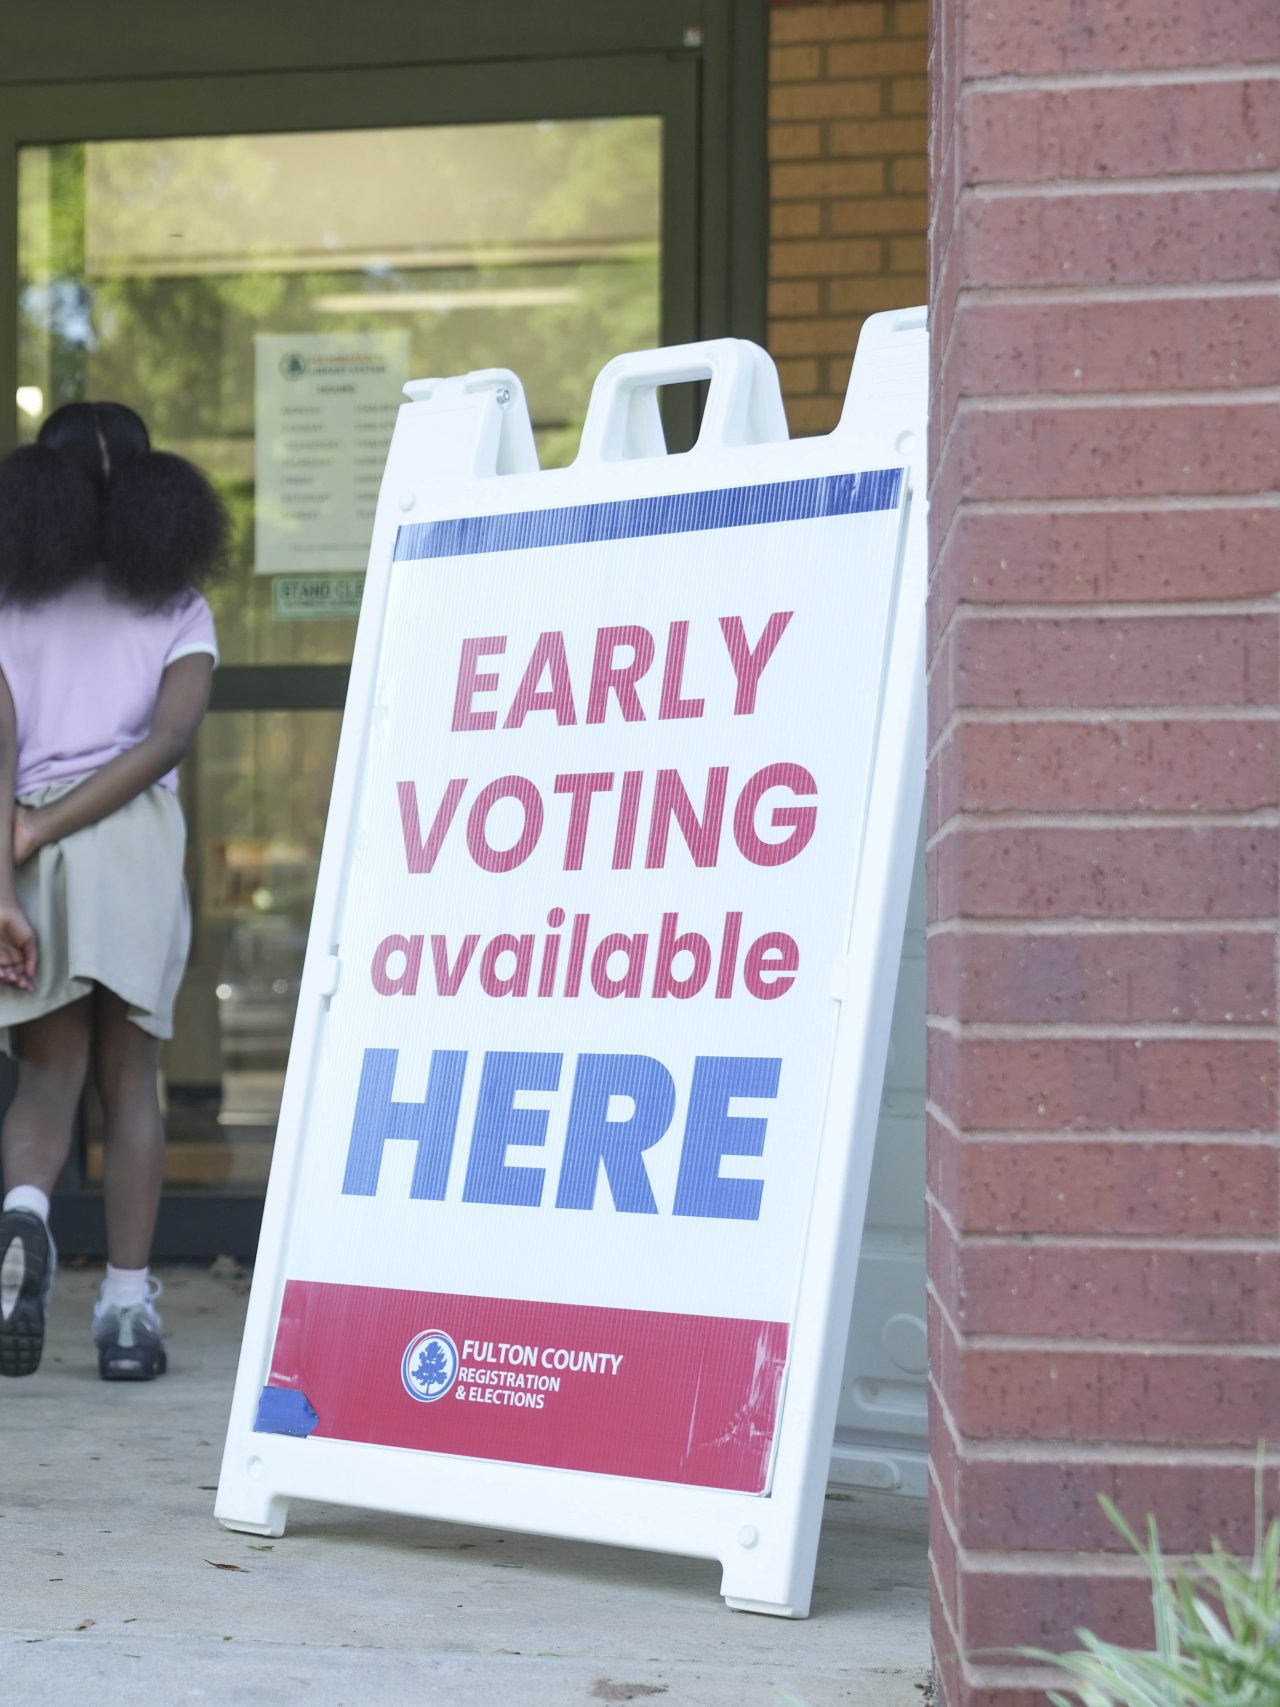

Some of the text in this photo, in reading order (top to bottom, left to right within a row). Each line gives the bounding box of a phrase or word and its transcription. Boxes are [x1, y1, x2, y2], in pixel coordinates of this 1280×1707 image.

[451, 611, 794, 732] EARLY
[396, 762, 818, 874] VOTING
[371, 907, 800, 1000] available
[341, 1048, 783, 1221] HERE
[455, 1385, 545, 1409] & ELECTIONS
[458, 1367, 560, 1392] REGISTRATION
[462, 1340, 623, 1375] FULTON COUNTY
